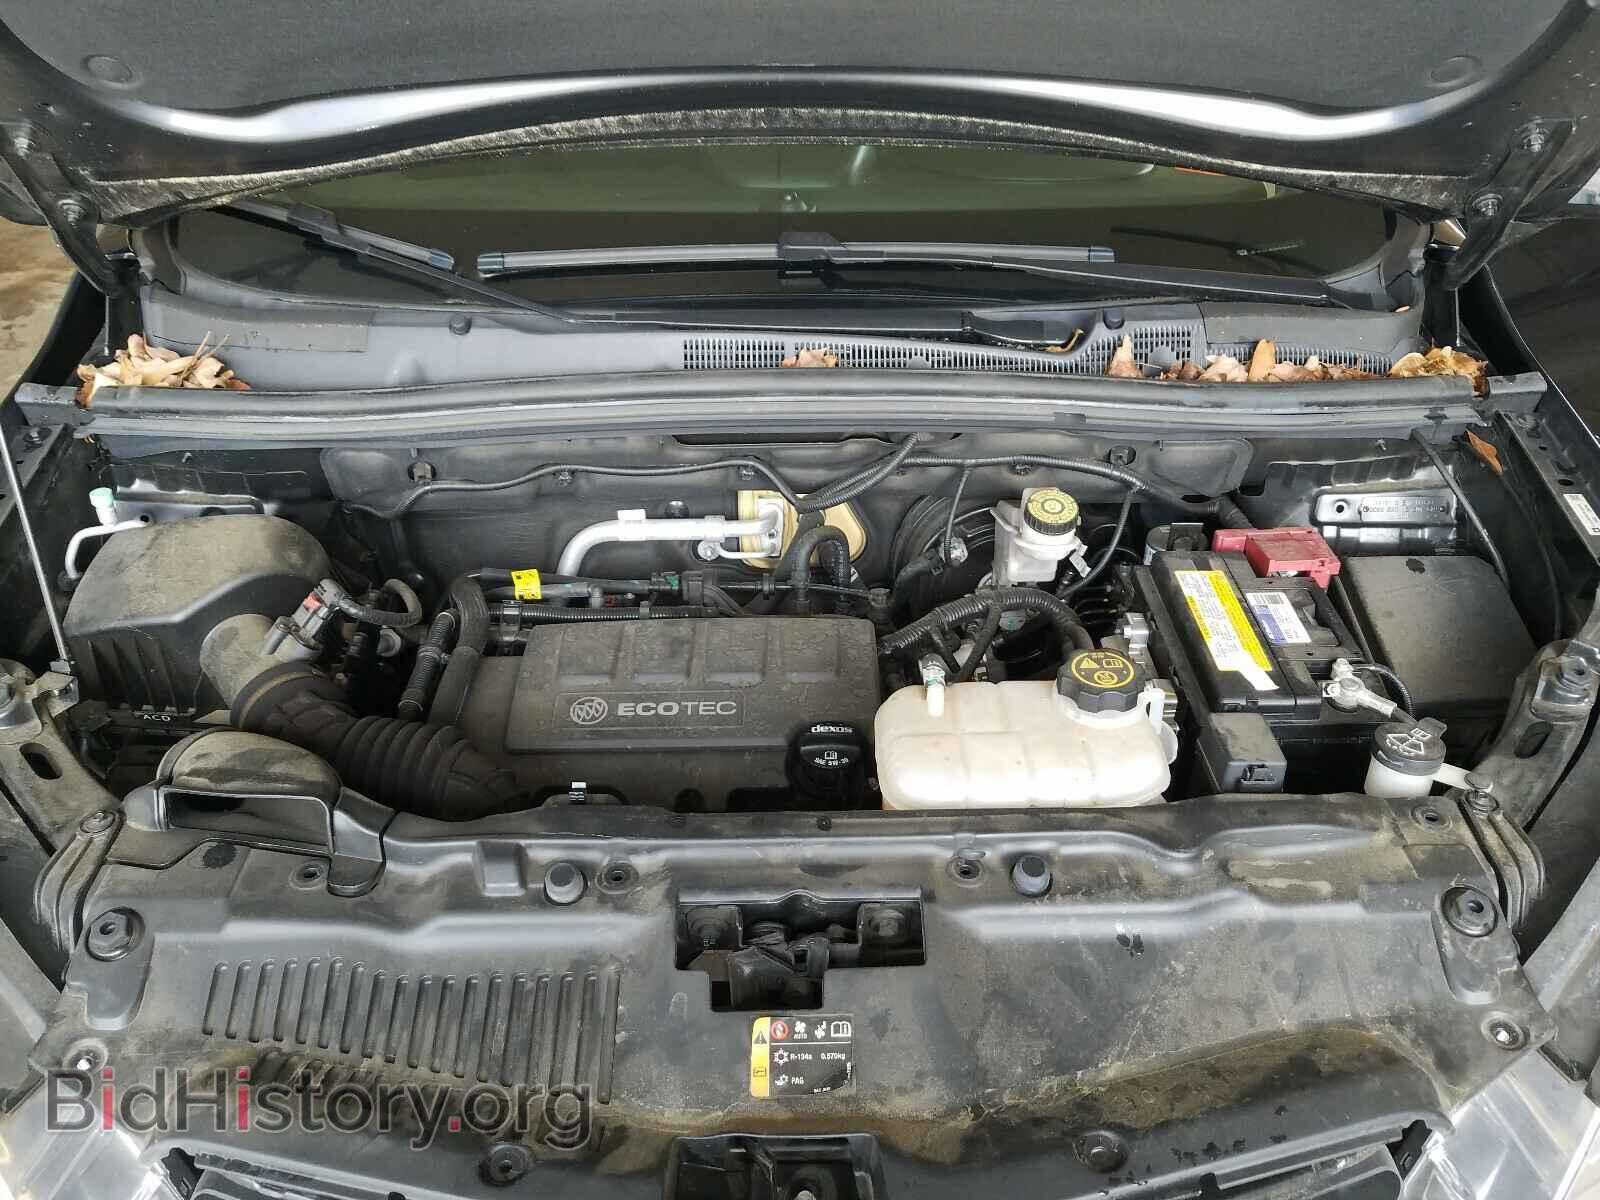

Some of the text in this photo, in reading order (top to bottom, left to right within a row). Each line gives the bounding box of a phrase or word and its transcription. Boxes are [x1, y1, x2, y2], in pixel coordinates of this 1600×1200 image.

[617, 701, 737, 716] ECOTEC
[811, 724, 853, 733] dexos
[790, 1052, 813, 1061] R-134a
[791, 1076, 805, 1085] PAG
